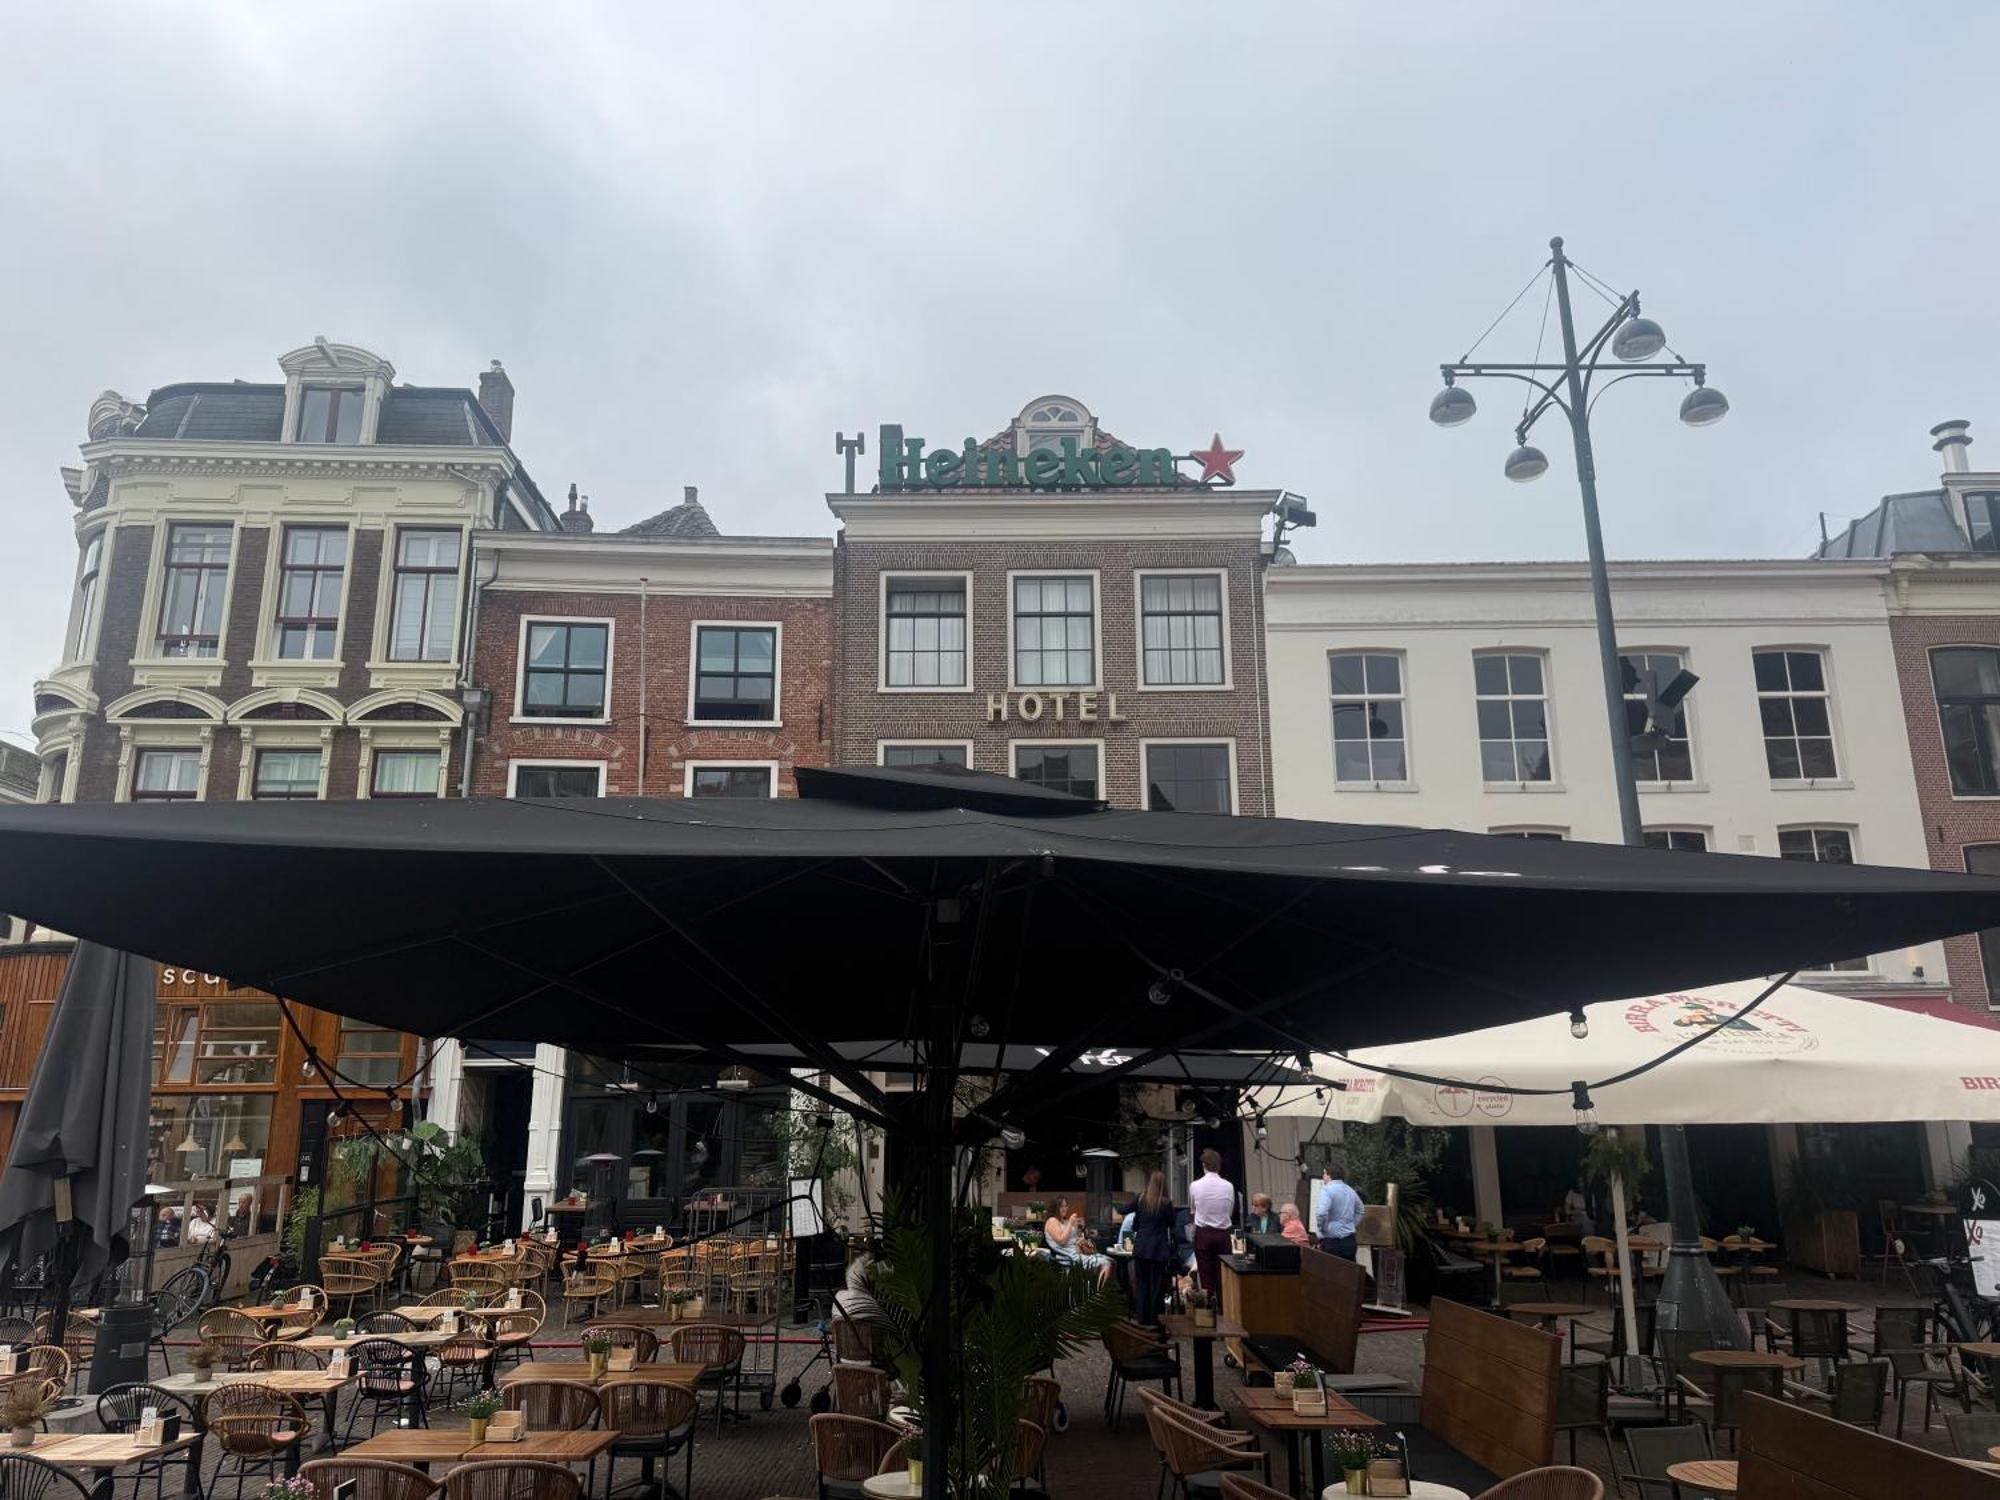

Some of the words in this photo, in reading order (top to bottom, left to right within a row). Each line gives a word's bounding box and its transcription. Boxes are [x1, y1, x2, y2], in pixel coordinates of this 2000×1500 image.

[879, 423, 1178, 486] Heineken
[986, 692, 1126, 721] HOTEL
[1625, 999, 1668, 1034] BIRRA
